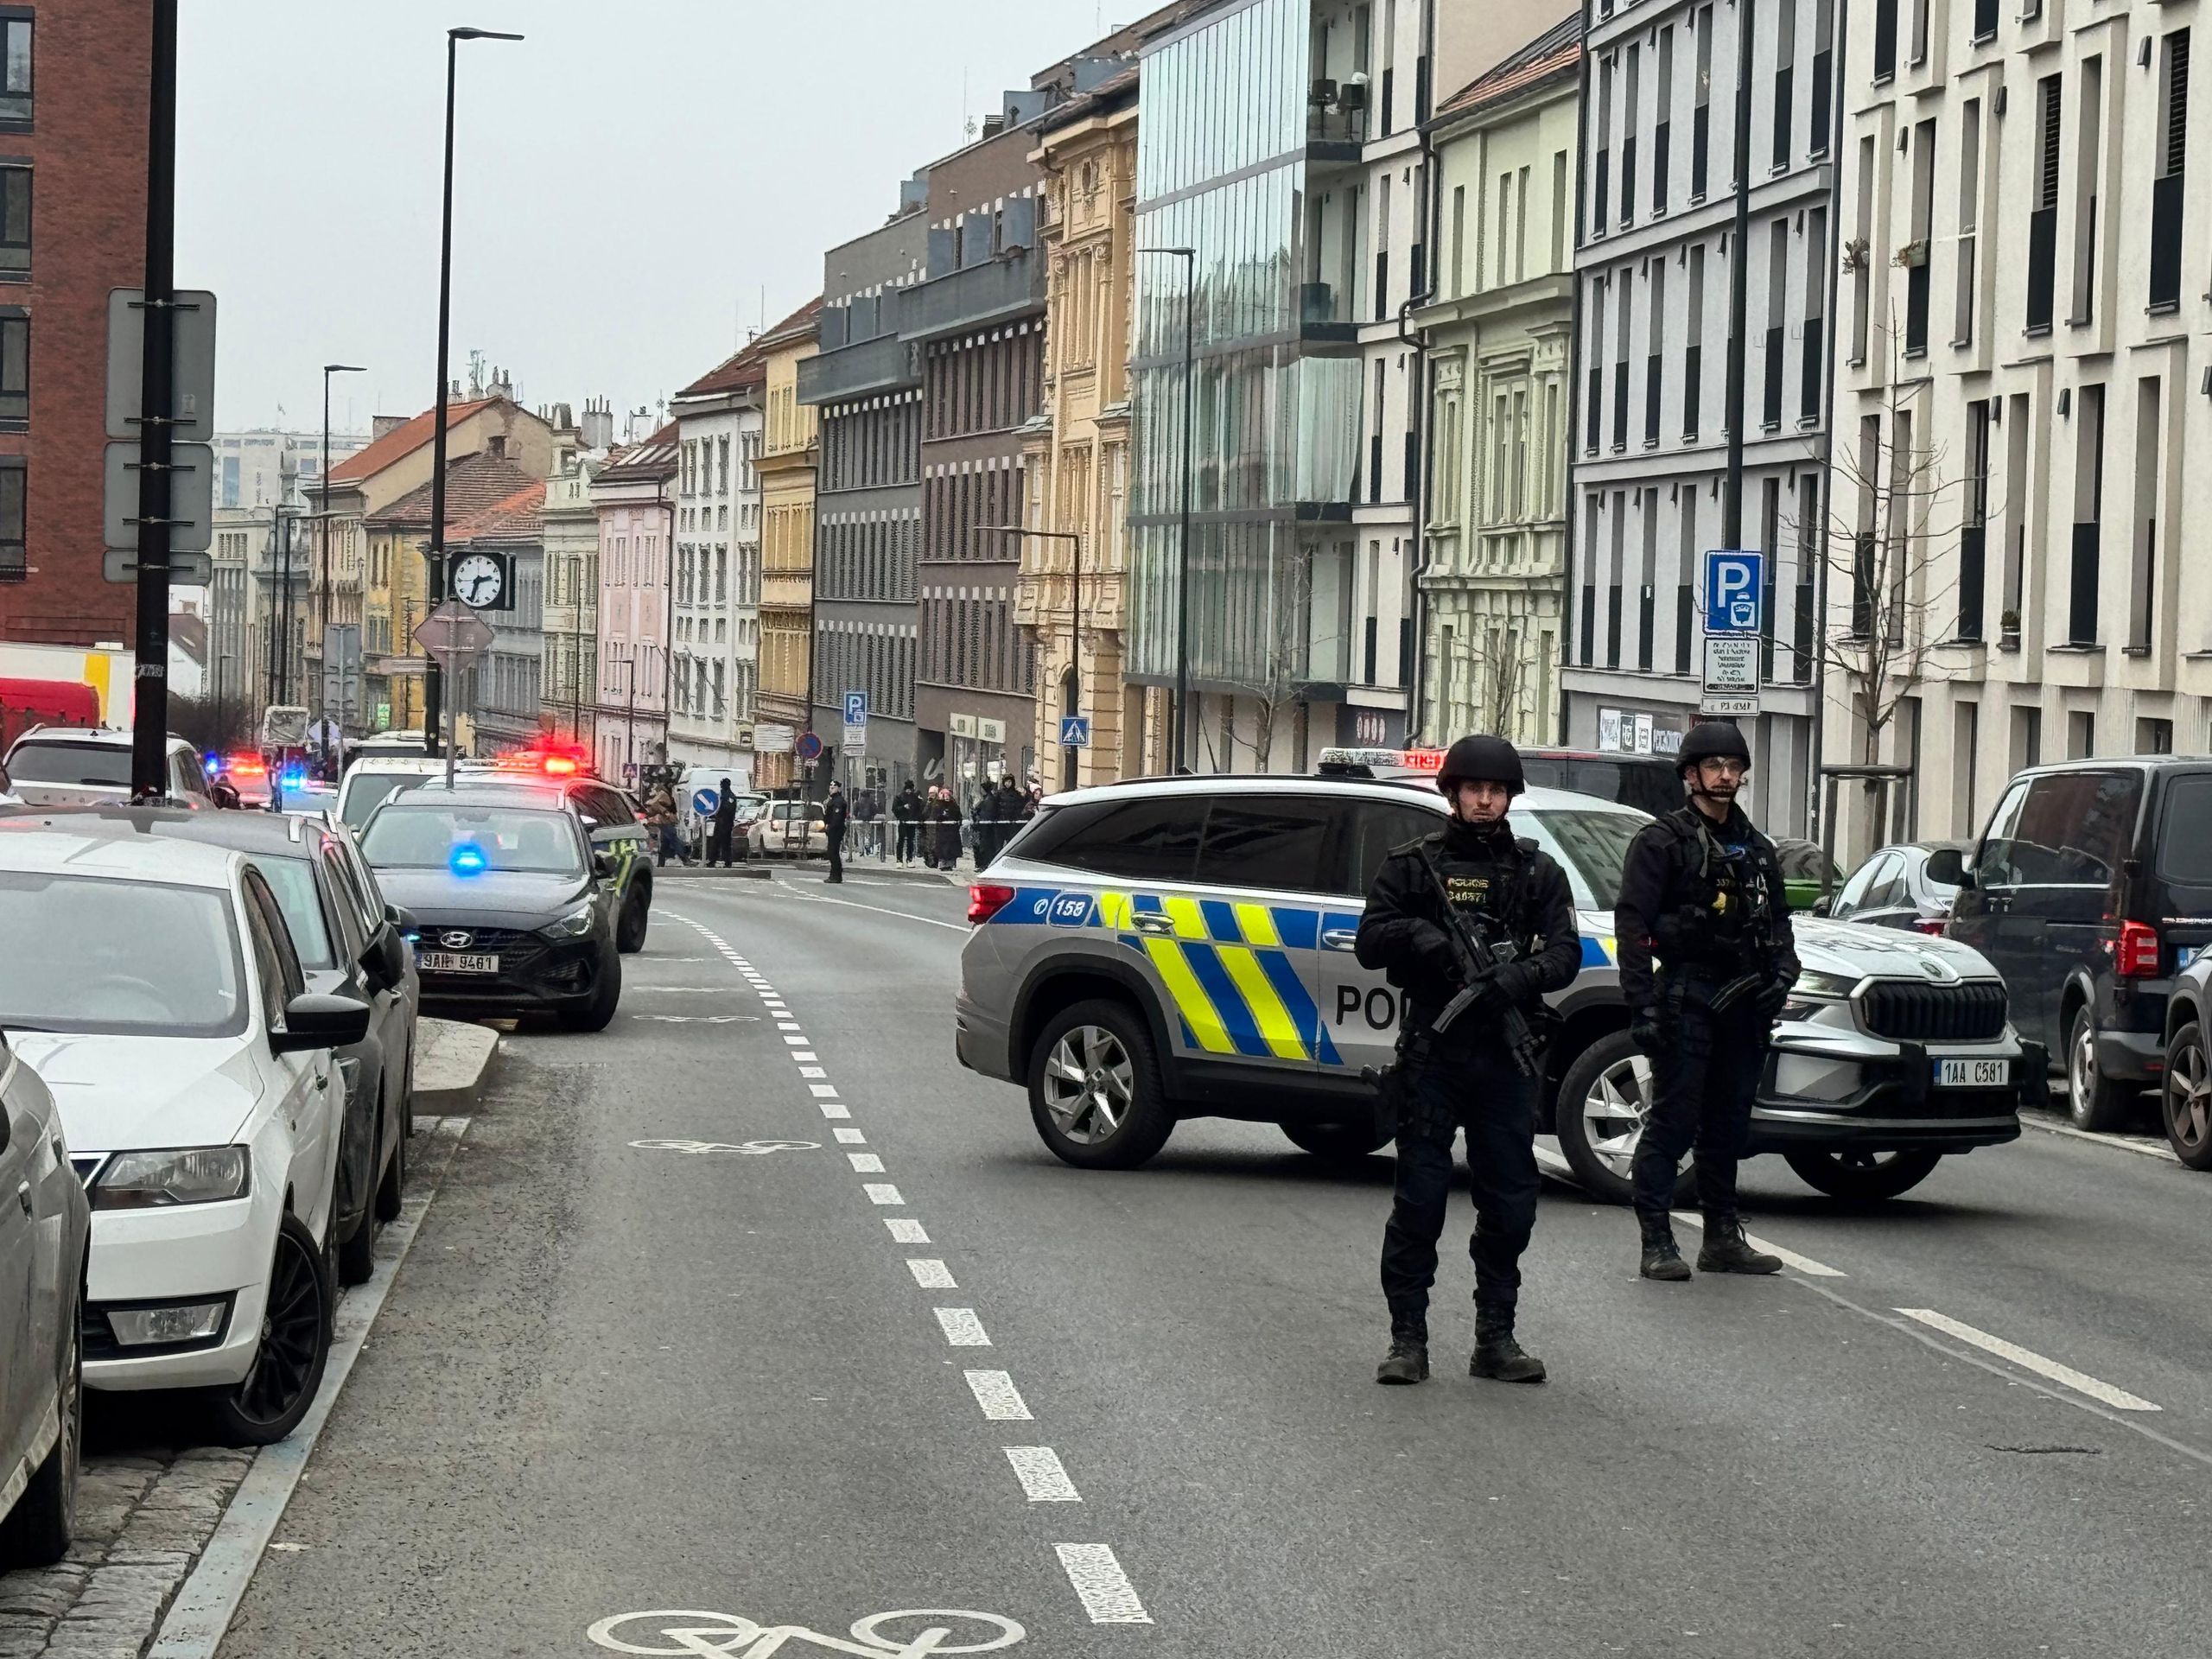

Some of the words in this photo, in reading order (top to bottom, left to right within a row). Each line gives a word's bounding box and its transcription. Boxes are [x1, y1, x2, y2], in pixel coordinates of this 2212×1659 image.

[1718, 562, 1751, 607] P
[849, 696, 862, 715] P
[1056, 899, 1085, 917] 158
[1945, 1062, 1966, 1084] 1AA
[1974, 1062, 2003, 1084] C581
